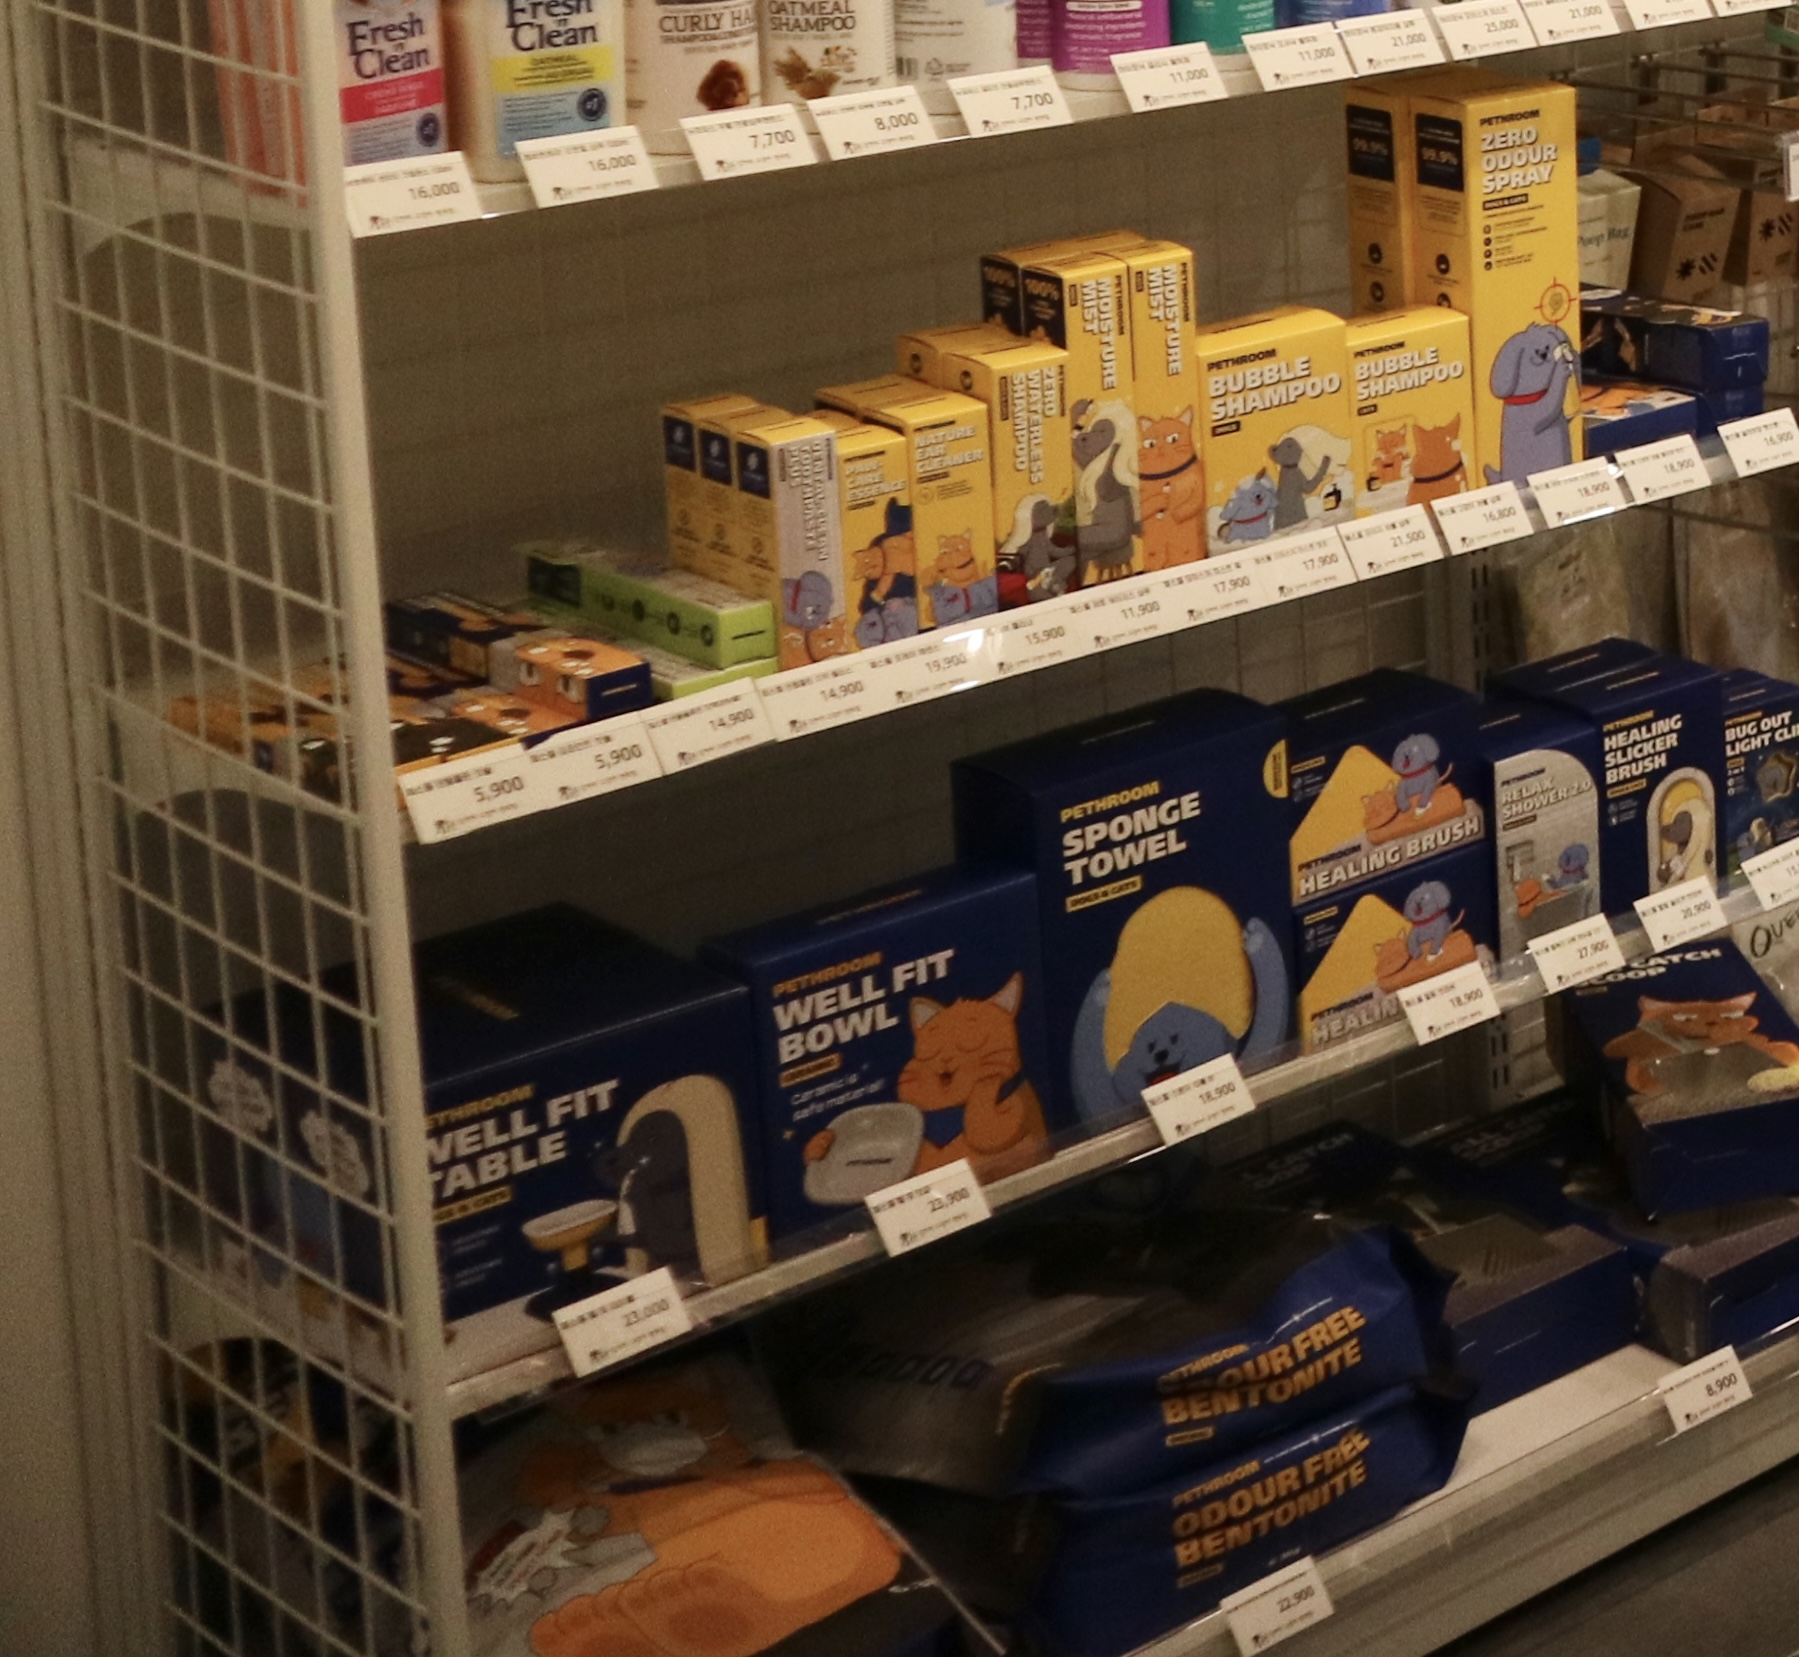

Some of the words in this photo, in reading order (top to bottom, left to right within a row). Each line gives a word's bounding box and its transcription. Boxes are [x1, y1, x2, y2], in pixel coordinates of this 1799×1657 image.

[767, 0, 855, 16] OATMEAL
[769, 15, 856, 32] SHAMPOO
[346, 13, 425, 57] Fresh
[511, 24, 598, 53] Clean
[353, 47, 430, 81] Clean
[748, 129, 796, 147] 7,700
[874, 112, 919, 131] 8,000
[1481, 127, 1538, 153] ZERO
[1481, 145, 1559, 174] ODOUR
[1482, 165, 1555, 196] SPRAY
[1147, 267, 1164, 323] MIST
[1162, 264, 1182, 377] MOISTURE
[1206, 348, 1277, 373] PETHROOM
[1208, 357, 1312, 401] BUBBLE
[1210, 373, 1343, 423] SHAMPOO
[914, 425, 976, 449] NATURE
[1027, 368, 1043, 484] WATERLESS
[915, 448, 985, 475] CLEANER
[1603, 714, 1683, 752] HEALING
[1724, 722, 1758, 743] BUG
[1760, 710, 1793, 732] OUT
[594, 743, 643, 770] 5,900
[1604, 734, 1679, 769] SLICKER
[1725, 733, 1772, 757] LIGHT
[1605, 752, 1668, 785] BRUSH
[1062, 793, 1202, 860] SPONGE
[1064, 831, 1189, 887] TOWEL
[1297, 845, 1403, 900] HEALING
[1405, 815, 1481, 865] BRUSH
[772, 976, 887, 1032] WELL
[892, 949, 955, 994] FIT
[778, 1006, 899, 1065] BOWL
[927, 1185, 971, 1215] 23,900
[1704, 1370, 1738, 1396] 8,900
[1173, 1465, 1300, 1538] ODOUR
[1303, 1428, 1371, 1483] FREE
[1175, 1459, 1368, 1567] BENTONITE
